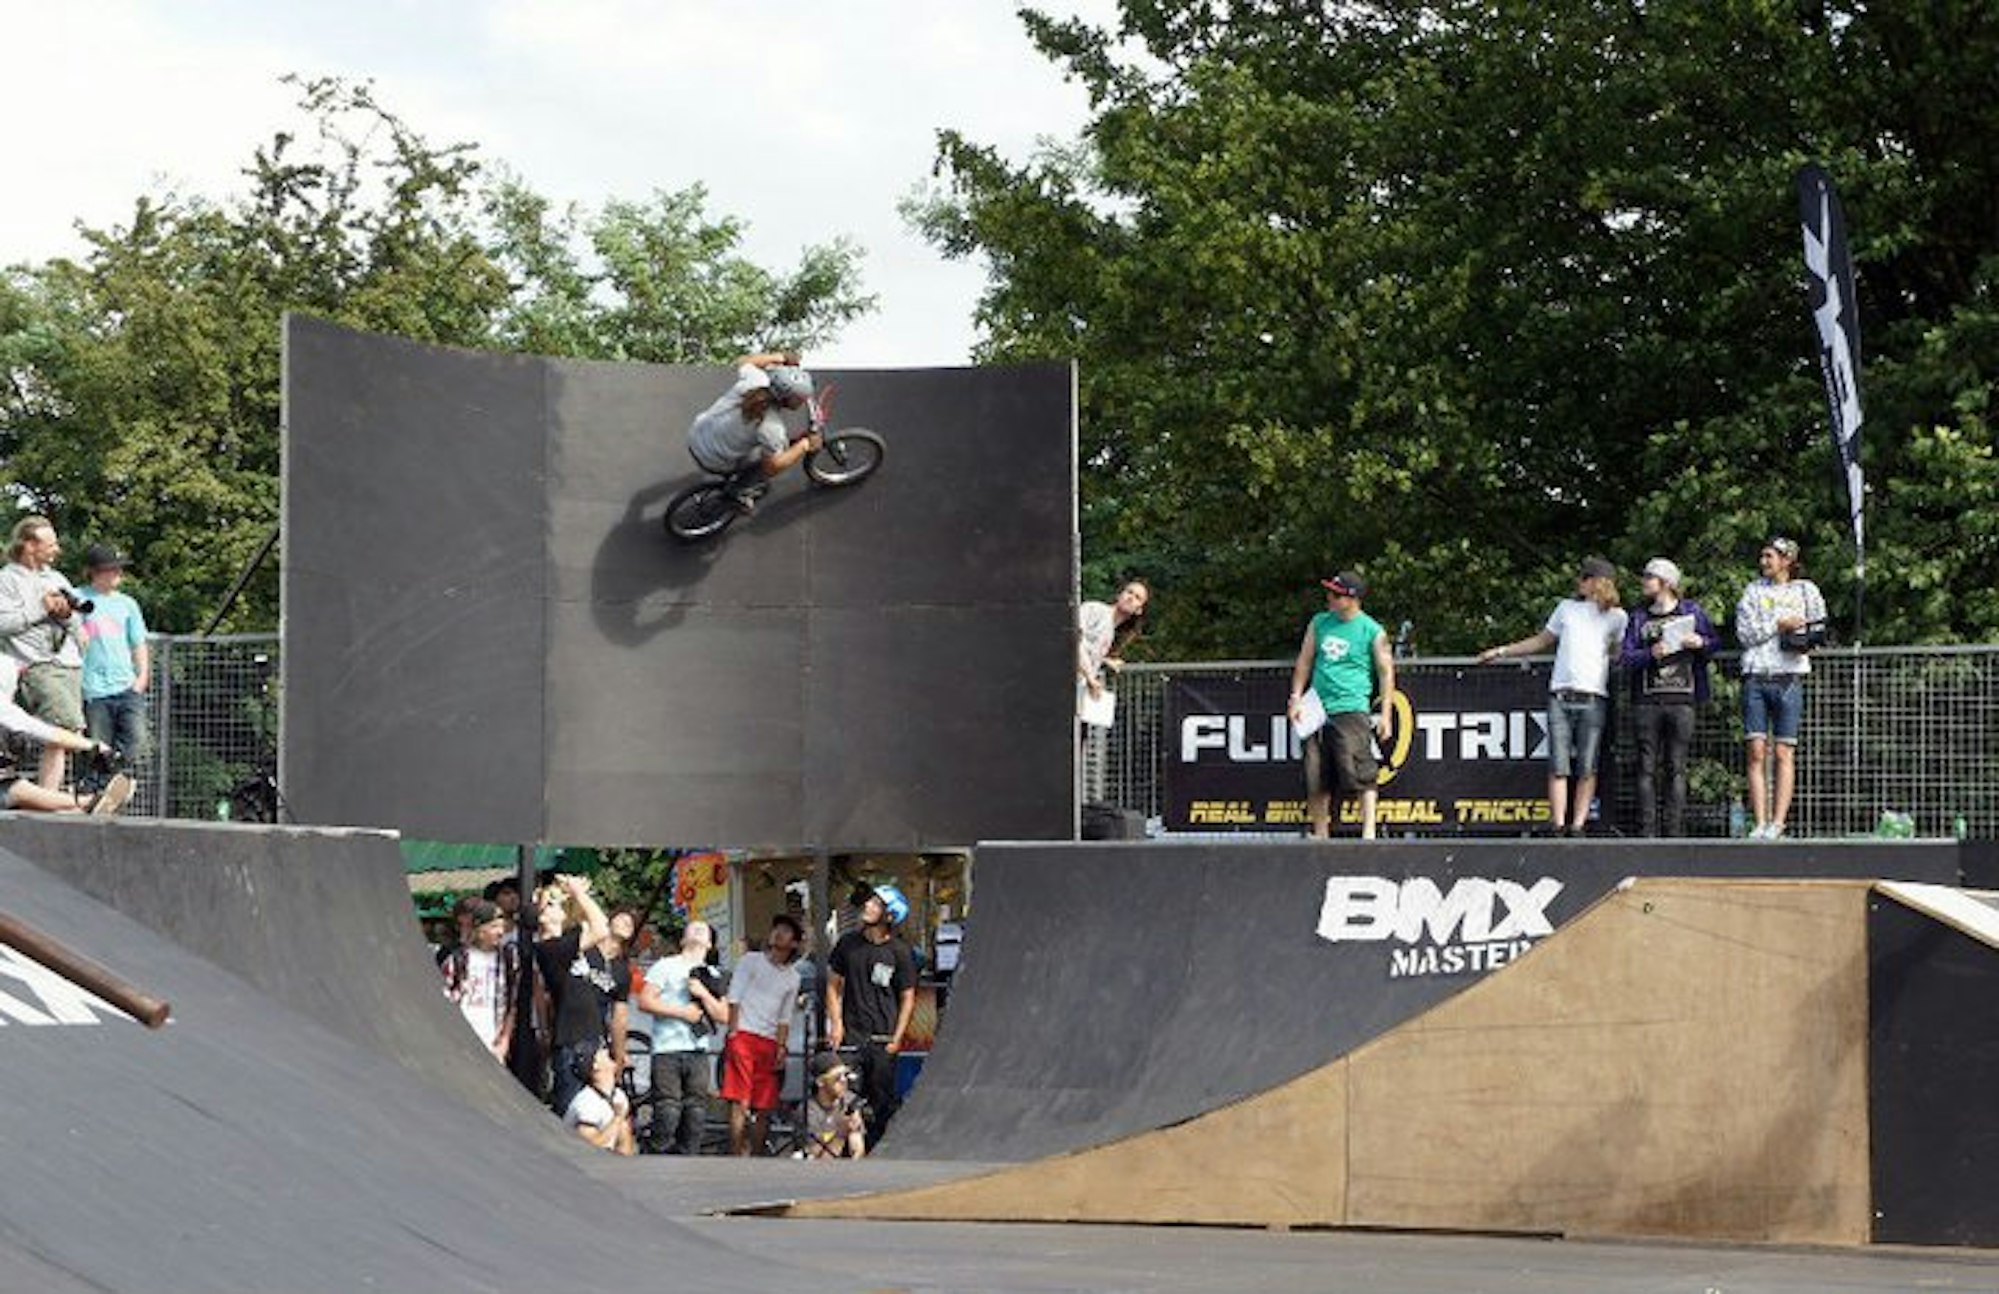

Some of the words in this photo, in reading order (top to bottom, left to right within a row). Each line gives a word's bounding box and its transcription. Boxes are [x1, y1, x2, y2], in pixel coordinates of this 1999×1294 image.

[1190, 801, 1257, 824] REAL
[1340, 801, 1443, 824] UREAL
[1454, 801, 1551, 823] TRICKS
[1316, 876, 1564, 945] BMX
